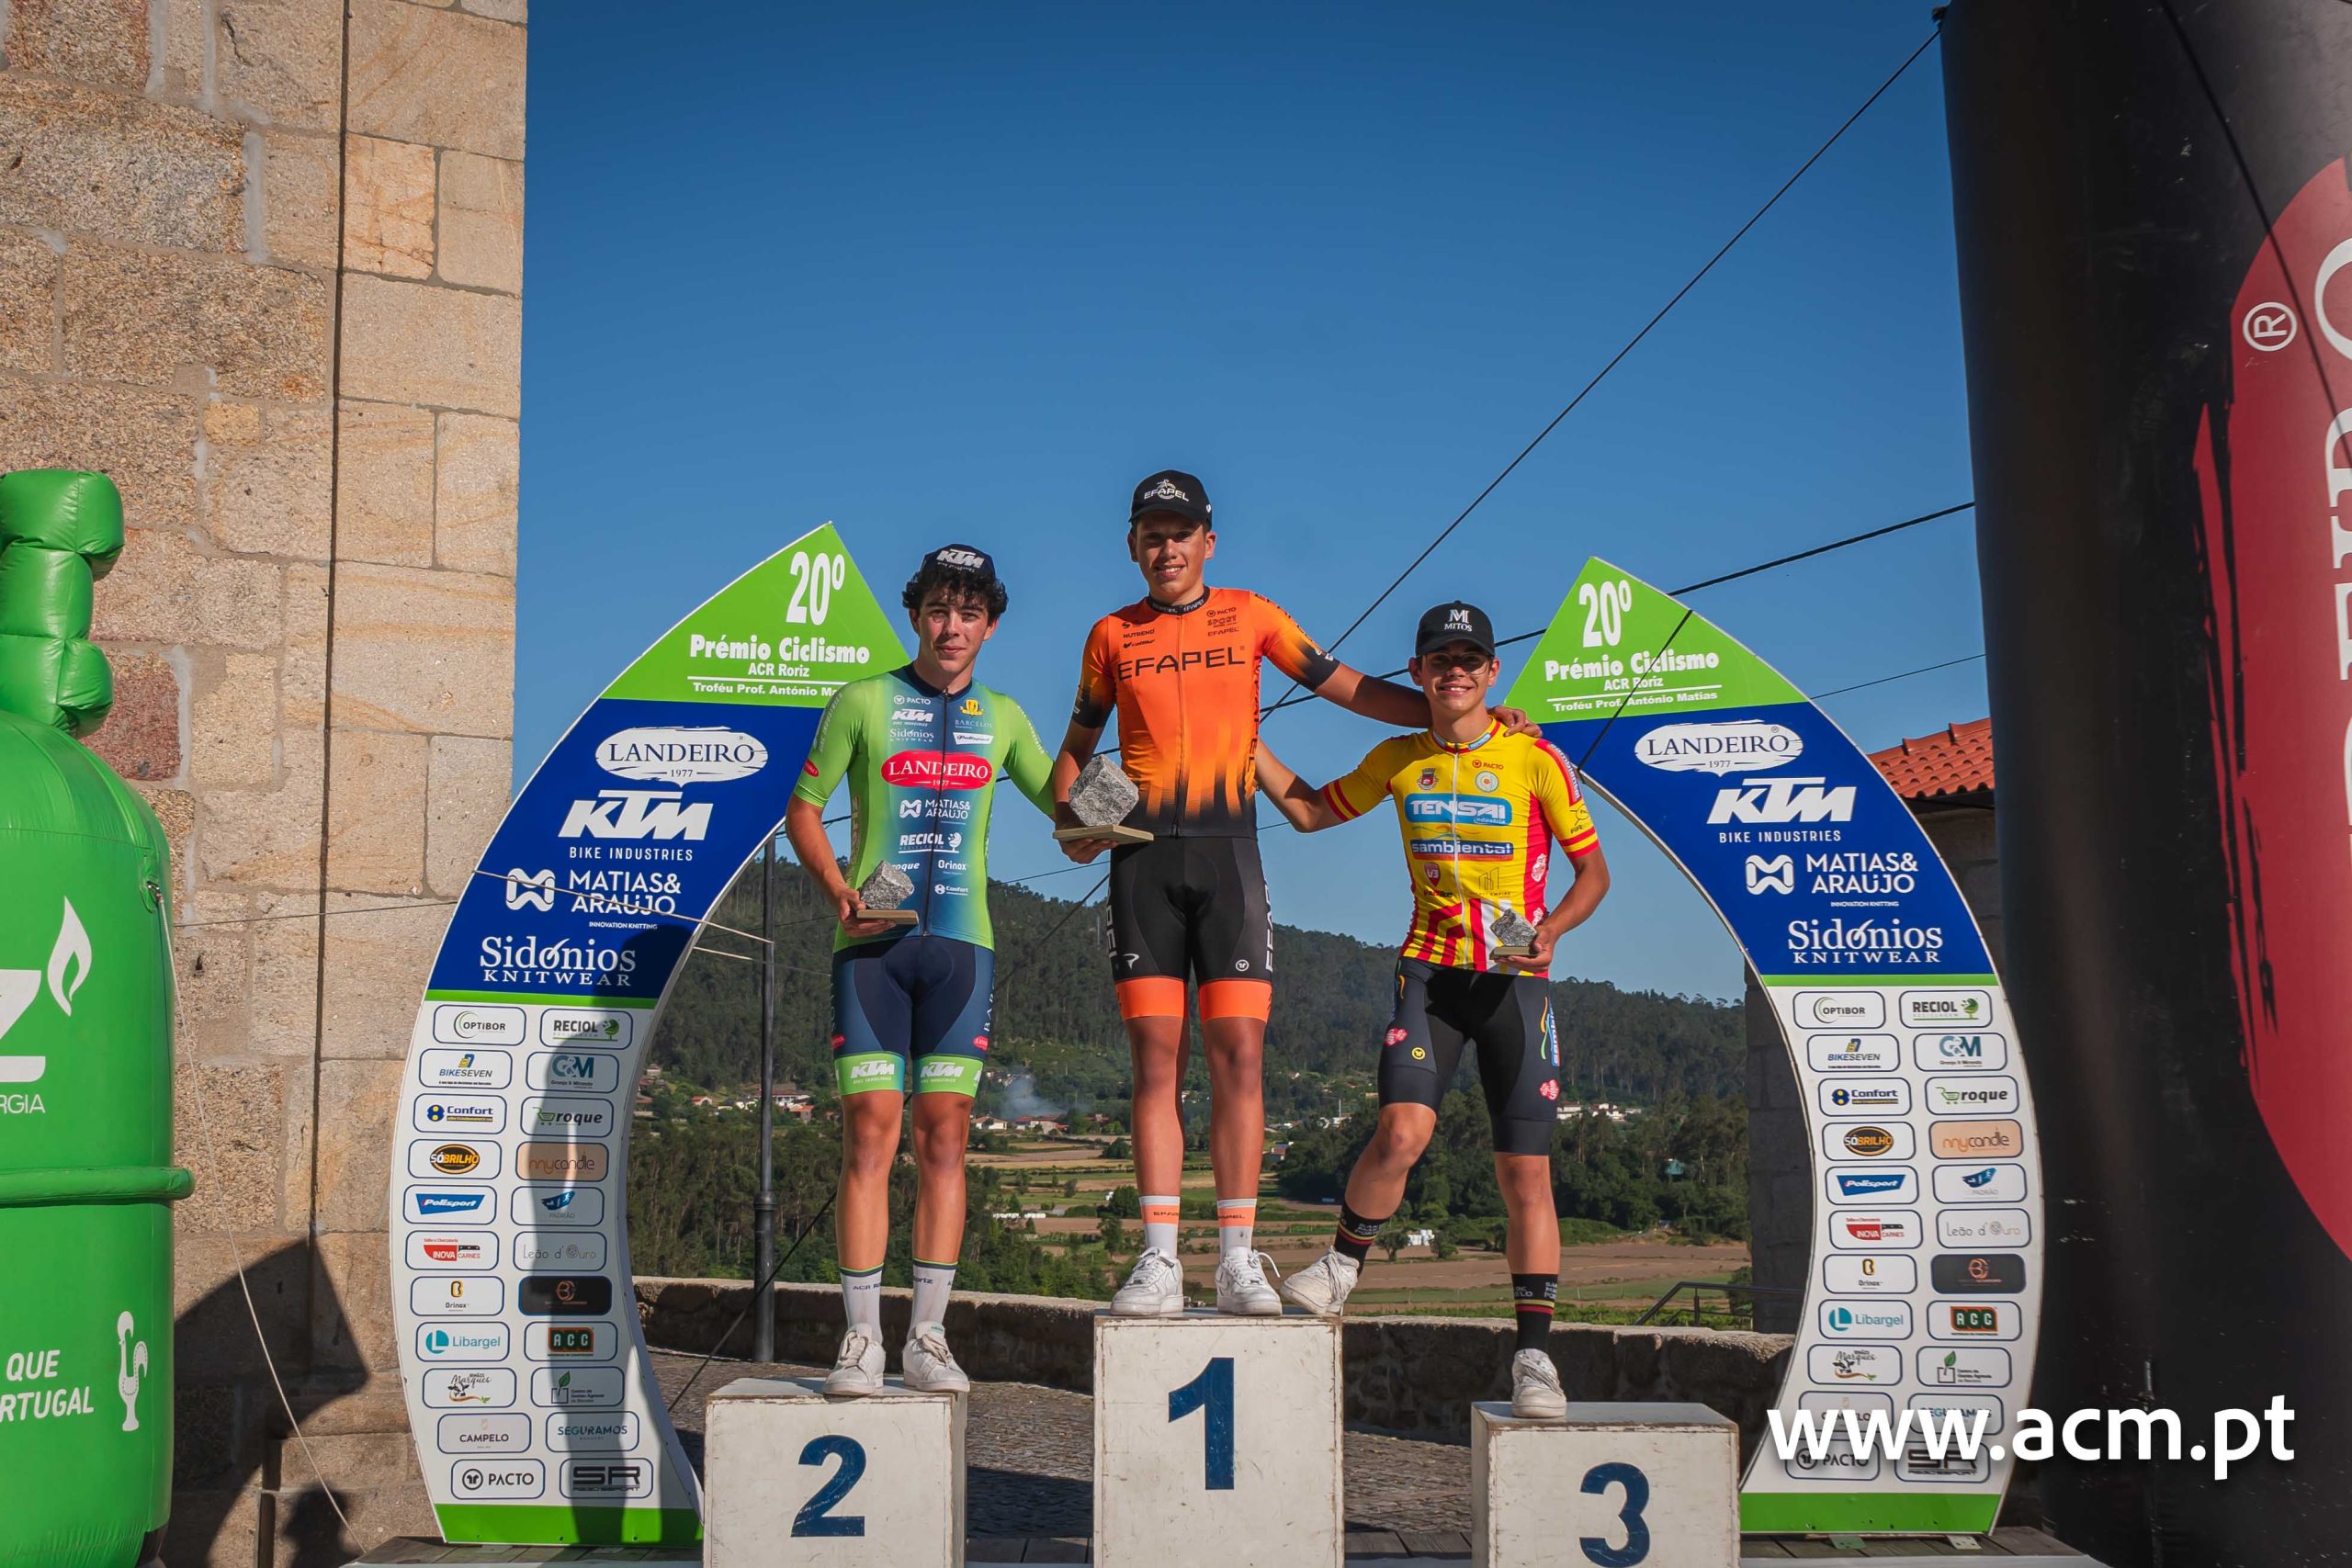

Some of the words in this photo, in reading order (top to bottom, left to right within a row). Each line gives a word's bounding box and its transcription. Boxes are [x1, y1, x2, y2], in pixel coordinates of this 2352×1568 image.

[1144, 488, 1190, 502] EFAPEL
[936, 548, 986, 569] KTM
[1217, 606, 1237, 615] PACTO
[1123, 628, 1155, 638] NUTREND
[1208, 627, 1238, 637] EFAPEL
[1444, 623, 1473, 632] MITOS
[690, 634, 772, 660] Prémio
[779, 636, 870, 663] Ciclismo
[748, 662, 775, 676] ACR
[778, 664, 809, 677] Roriz
[1117, 646, 1246, 682] EFAPEL
[1545, 655, 1623, 682] Prémio
[1631, 650, 1720, 675] Ciclismo
[693, 682, 733, 694] Troféu
[737, 683, 765, 694] Prof.
[769, 684, 818, 696] António
[1603, 678, 1629, 692] ACR
[1634, 676, 1664, 689] Roriz
[907, 697, 931, 705] PACTO
[1553, 700, 1593, 712] Troféu
[1596, 697, 1623, 709] Prof.
[1627, 694, 1672, 707] António
[1676, 691, 1718, 704] Matias
[891, 708, 933, 722] KTM
[889, 728, 934, 739] Sidónios
[1647, 734, 1790, 757] LANDEIRO
[608, 740, 755, 766] LANDEIRO
[888, 761, 989, 779] LANDEIRO
[1483, 761, 1504, 770] PACTO
[1709, 760, 1731, 769] 1977
[671, 769, 694, 778] 1977
[925, 798, 970, 810] MATIAS&
[1706, 777, 1858, 825] KTM
[559, 790, 714, 840] KTM
[1410, 800, 1506, 819] TENSAI
[1719, 831, 1751, 843] BIKE
[1758, 829, 1841, 843] INDUSTRIES
[570, 846, 603, 861] BIKE
[609, 846, 694, 862] INDUSTRIES
[1411, 841, 1510, 854] sambiental
[938, 860, 967, 871] Brinox
[1807, 852, 1918, 874] MATIAS&
[570, 869, 682, 895] MATIAS&
[589, 921, 628, 930] INNOVATION
[628, 922, 658, 931] KNITTING
[1788, 919, 1943, 951] Sidónios
[480, 936, 636, 974] Sidónios
[1793, 951, 1941, 964] KNITWEAR
[483, 969, 632, 987] KNITWEAR
[1912, 1000, 1957, 1013] RECIOL
[463, 1021, 506, 1031] OPTIBOR
[553, 1020, 598, 1032] RECIOL
[439, 1069, 493, 1077] BIKESEVEN
[851, 1060, 895, 1077] KTM
[920, 1061, 965, 1077] KTM
[1851, 1089, 1899, 1098] Confort
[1961, 1090, 2007, 1103] roque
[447, 1106, 494, 1115] Confort
[556, 1112, 603, 1126] roque
[1942, 1131, 2009, 1152] mycandle
[528, 1155, 595, 1175] mycandle
[424, 1199, 477, 1207] Polisport
[1946, 1222, 1973, 1236] Leão
[433, 1250, 456, 1258] INOVA
[524, 1244, 549, 1259] Leão
[1856, 1314, 1904, 1327] Libargel
[453, 1336, 501, 1349] Libargel
[6, 1349, 61, 1382] QUE
[558, 1426, 628, 1436] SEGURAMOS
[1168, 1357, 1236, 1491] 1
[459, 1433, 509, 1443] CAMPELO
[488, 1472, 535, 1485] PACTO
[790, 1434, 867, 1538] 2
[1579, 1462, 1651, 1568] 3
